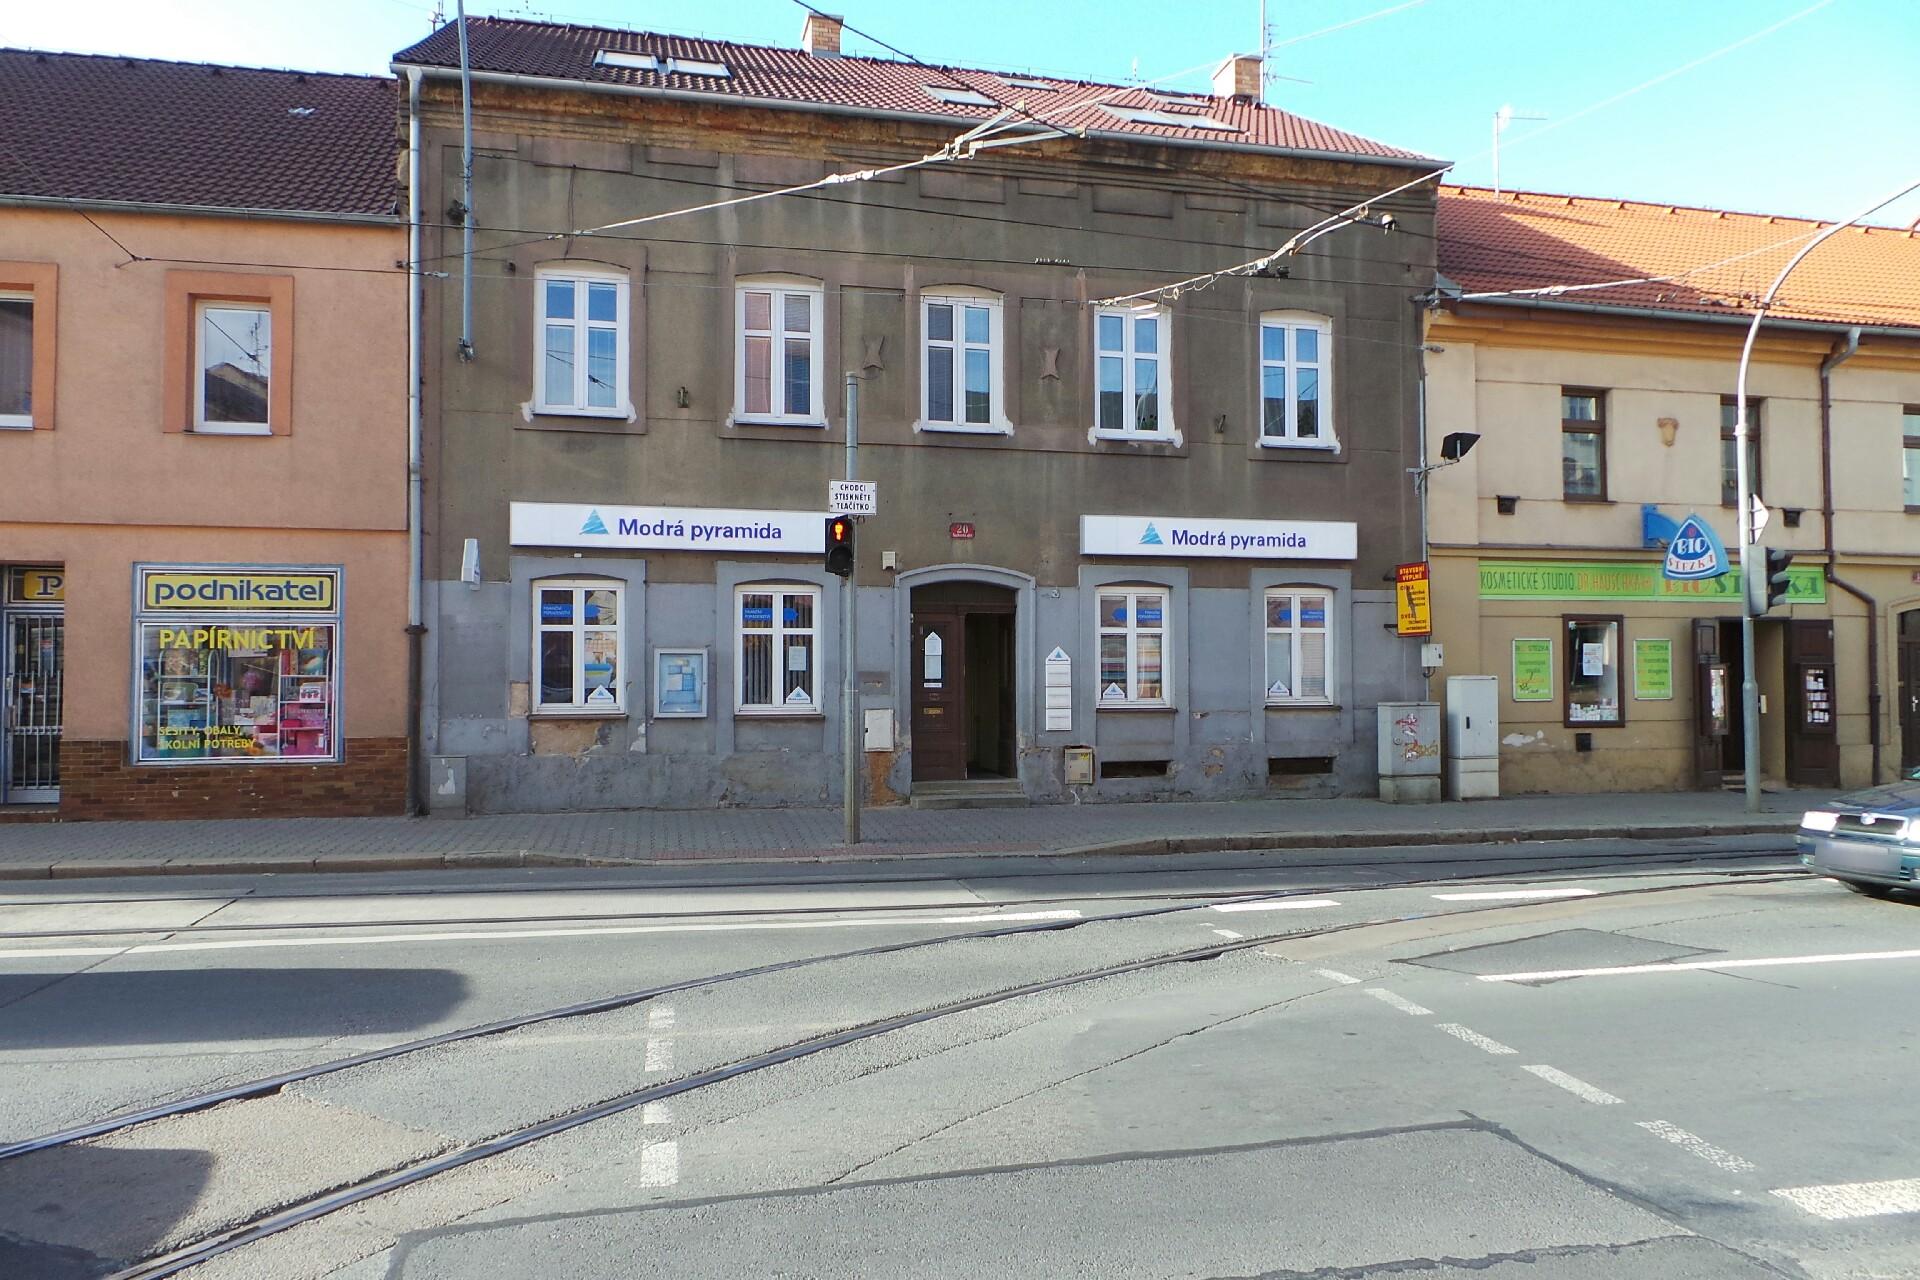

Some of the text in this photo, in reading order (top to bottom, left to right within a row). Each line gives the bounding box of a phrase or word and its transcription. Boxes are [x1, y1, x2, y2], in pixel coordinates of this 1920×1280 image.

[834, 493, 871, 501] STISKNĚTE
[836, 501, 870, 510] TLAČÍTKO
[618, 517, 782, 541] Modrá pyramida
[1172, 529, 1307, 551] Modrá pyramida
[1675, 537, 1708, 555] BIO
[1480, 567, 1539, 591] KOSMETICKÉ
[1541, 571, 1575, 591] STUDIO
[155, 579, 324, 605] podnikatel
[159, 626, 314, 649] PAPÍRNICTVÍ
[204, 725, 242, 736] OBALY,
[204, 737, 257, 749] POTŘEBY
